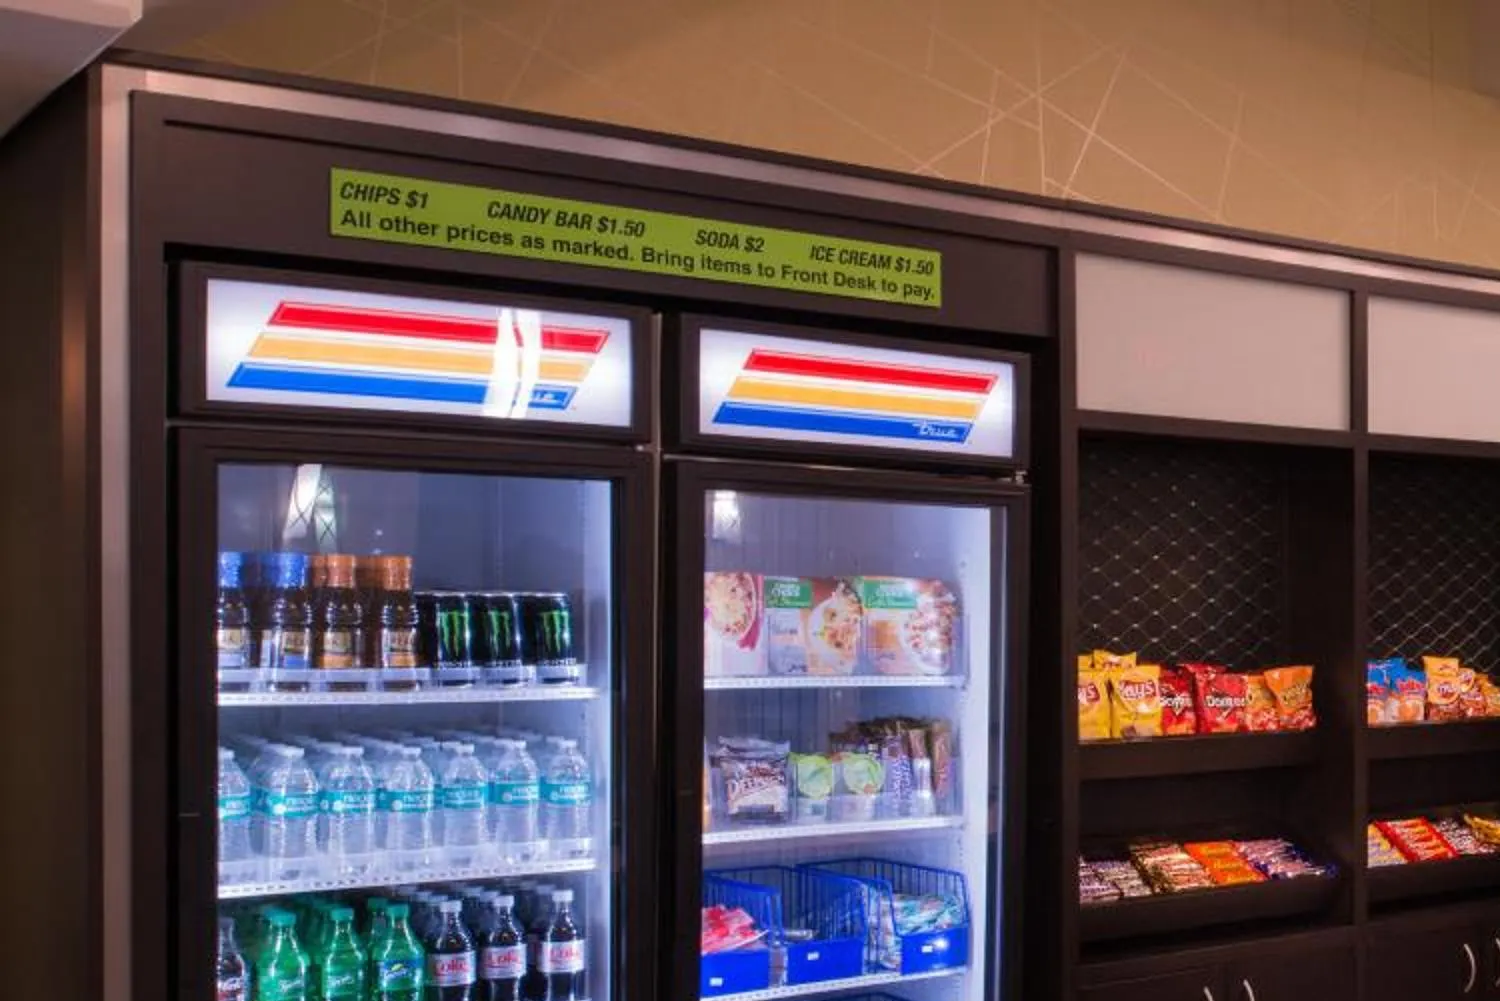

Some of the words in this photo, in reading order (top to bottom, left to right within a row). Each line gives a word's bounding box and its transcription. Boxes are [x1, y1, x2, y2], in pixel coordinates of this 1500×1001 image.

[340, 181, 401, 206] CHIPS
[405, 190, 429, 209] $1
[487, 200, 550, 223] CANDY
[555, 211, 592, 231] BAR
[597, 218, 645, 239] $1.50
[341, 209, 371, 229] All
[379, 213, 440, 237] other
[446, 224, 513, 246] prices
[520, 233, 545, 249] as
[552, 238, 634, 261] marked.
[641, 247, 695, 273] Bring
[701, 253, 752, 276] items
[757, 261, 775, 279] to
[781, 265, 829, 286] Front
[834, 271, 876, 291] Desk
[881, 279, 898, 293] to
[903, 281, 935, 300] pay.
[695, 229, 740, 252] SODA
[744, 237, 765, 253] $2
[809, 245, 834, 261] ICE
[838, 249, 893, 270] CREAM
[894, 257, 934, 276] $1.50
